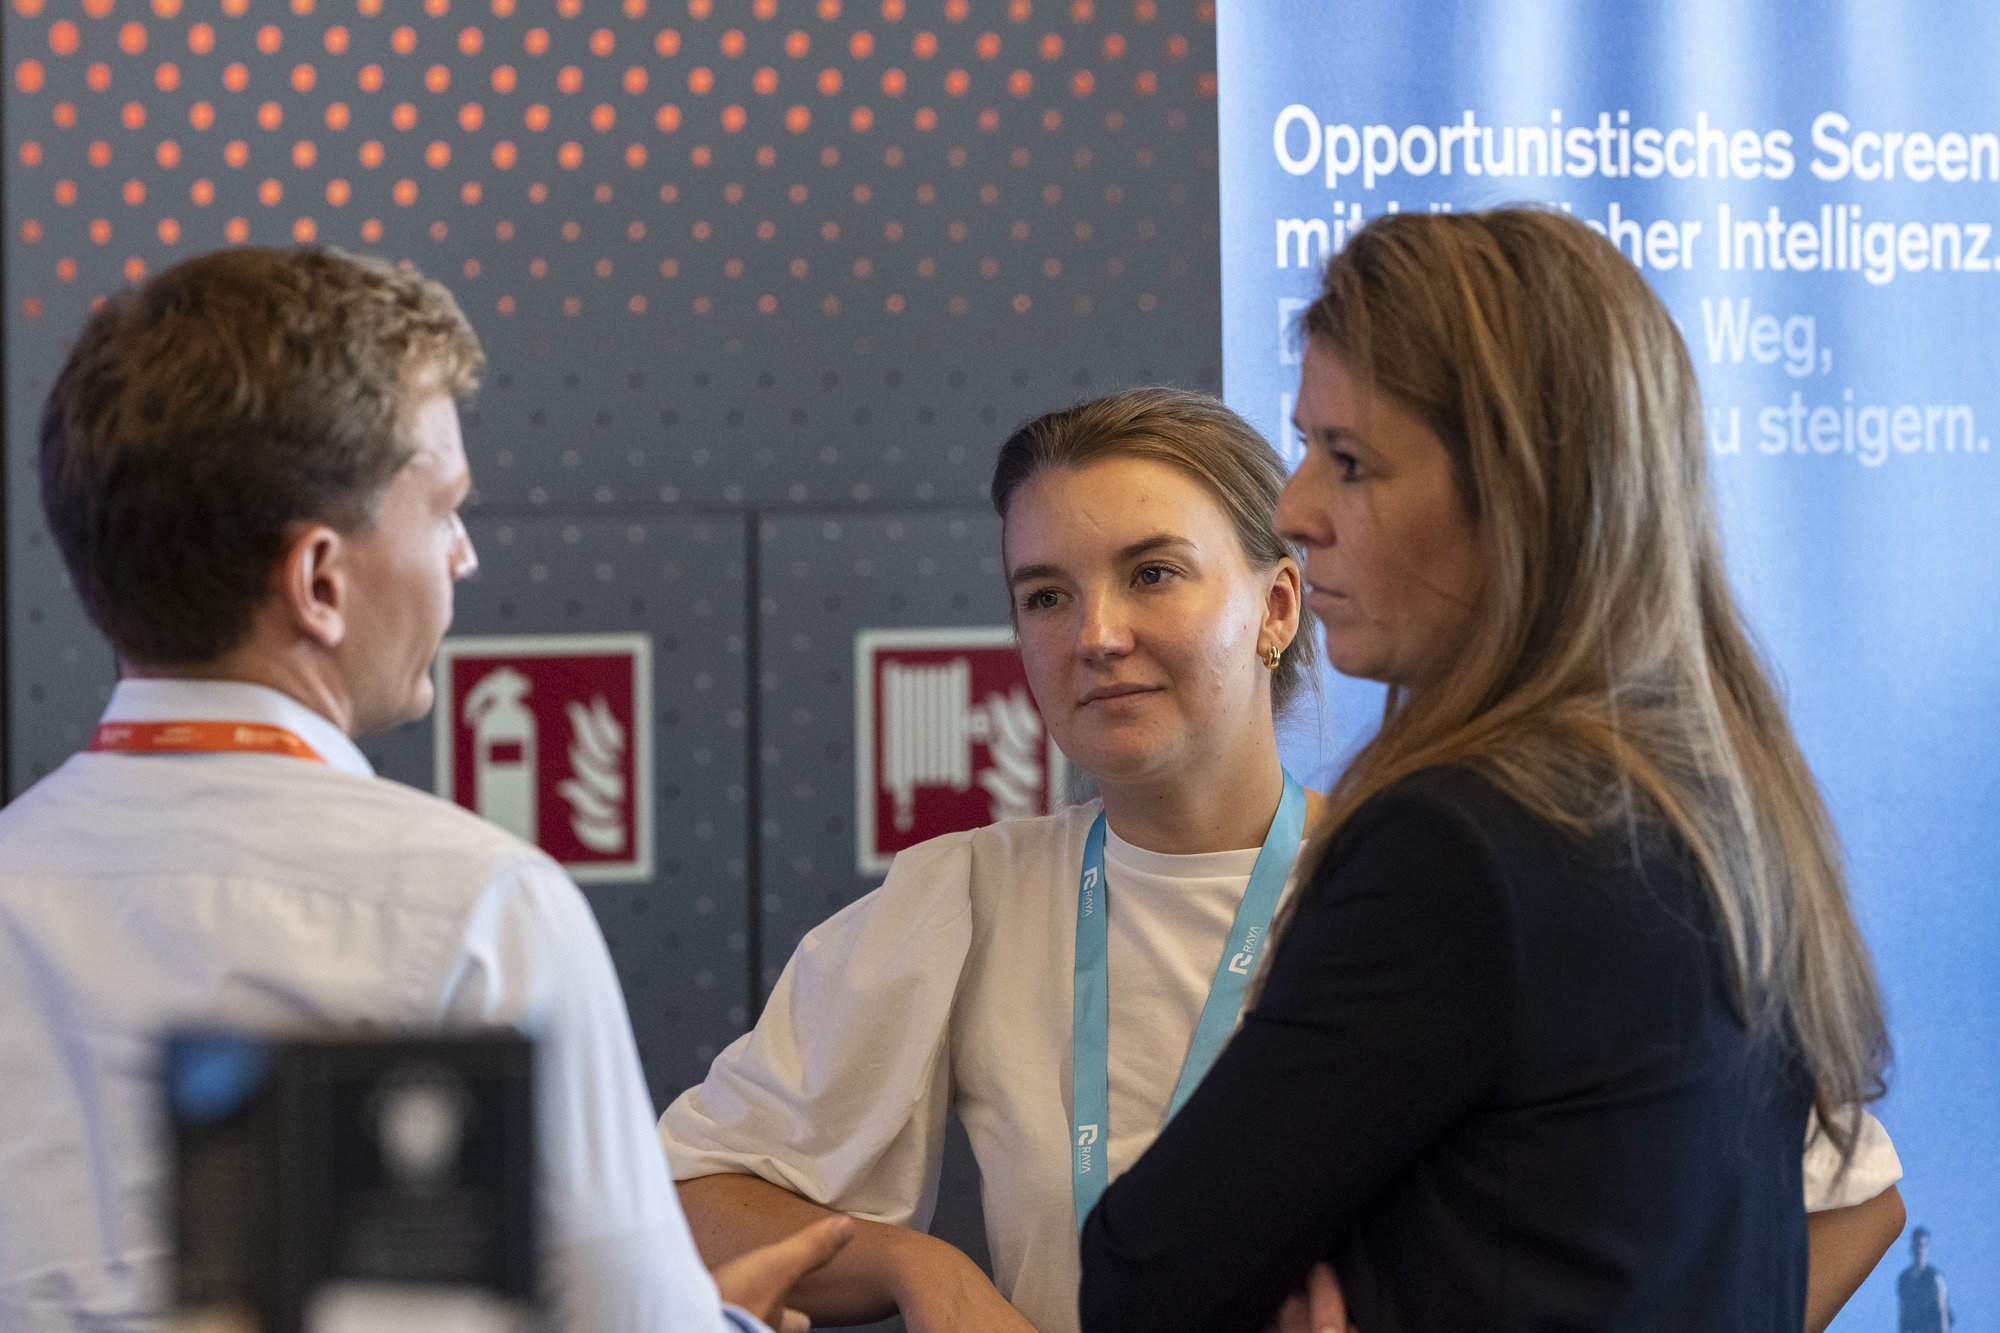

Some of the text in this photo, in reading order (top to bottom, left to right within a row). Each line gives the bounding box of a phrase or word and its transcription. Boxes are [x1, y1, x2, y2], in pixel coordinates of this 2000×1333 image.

[1273, 103, 2000, 189] Opportunistisches Screen
[1701, 296, 1833, 378] Weg,
[1758, 387, 1989, 468] steigern.
[1242, 926, 1261, 953] RAYA
[1081, 1146, 1091, 1174] RAYA
